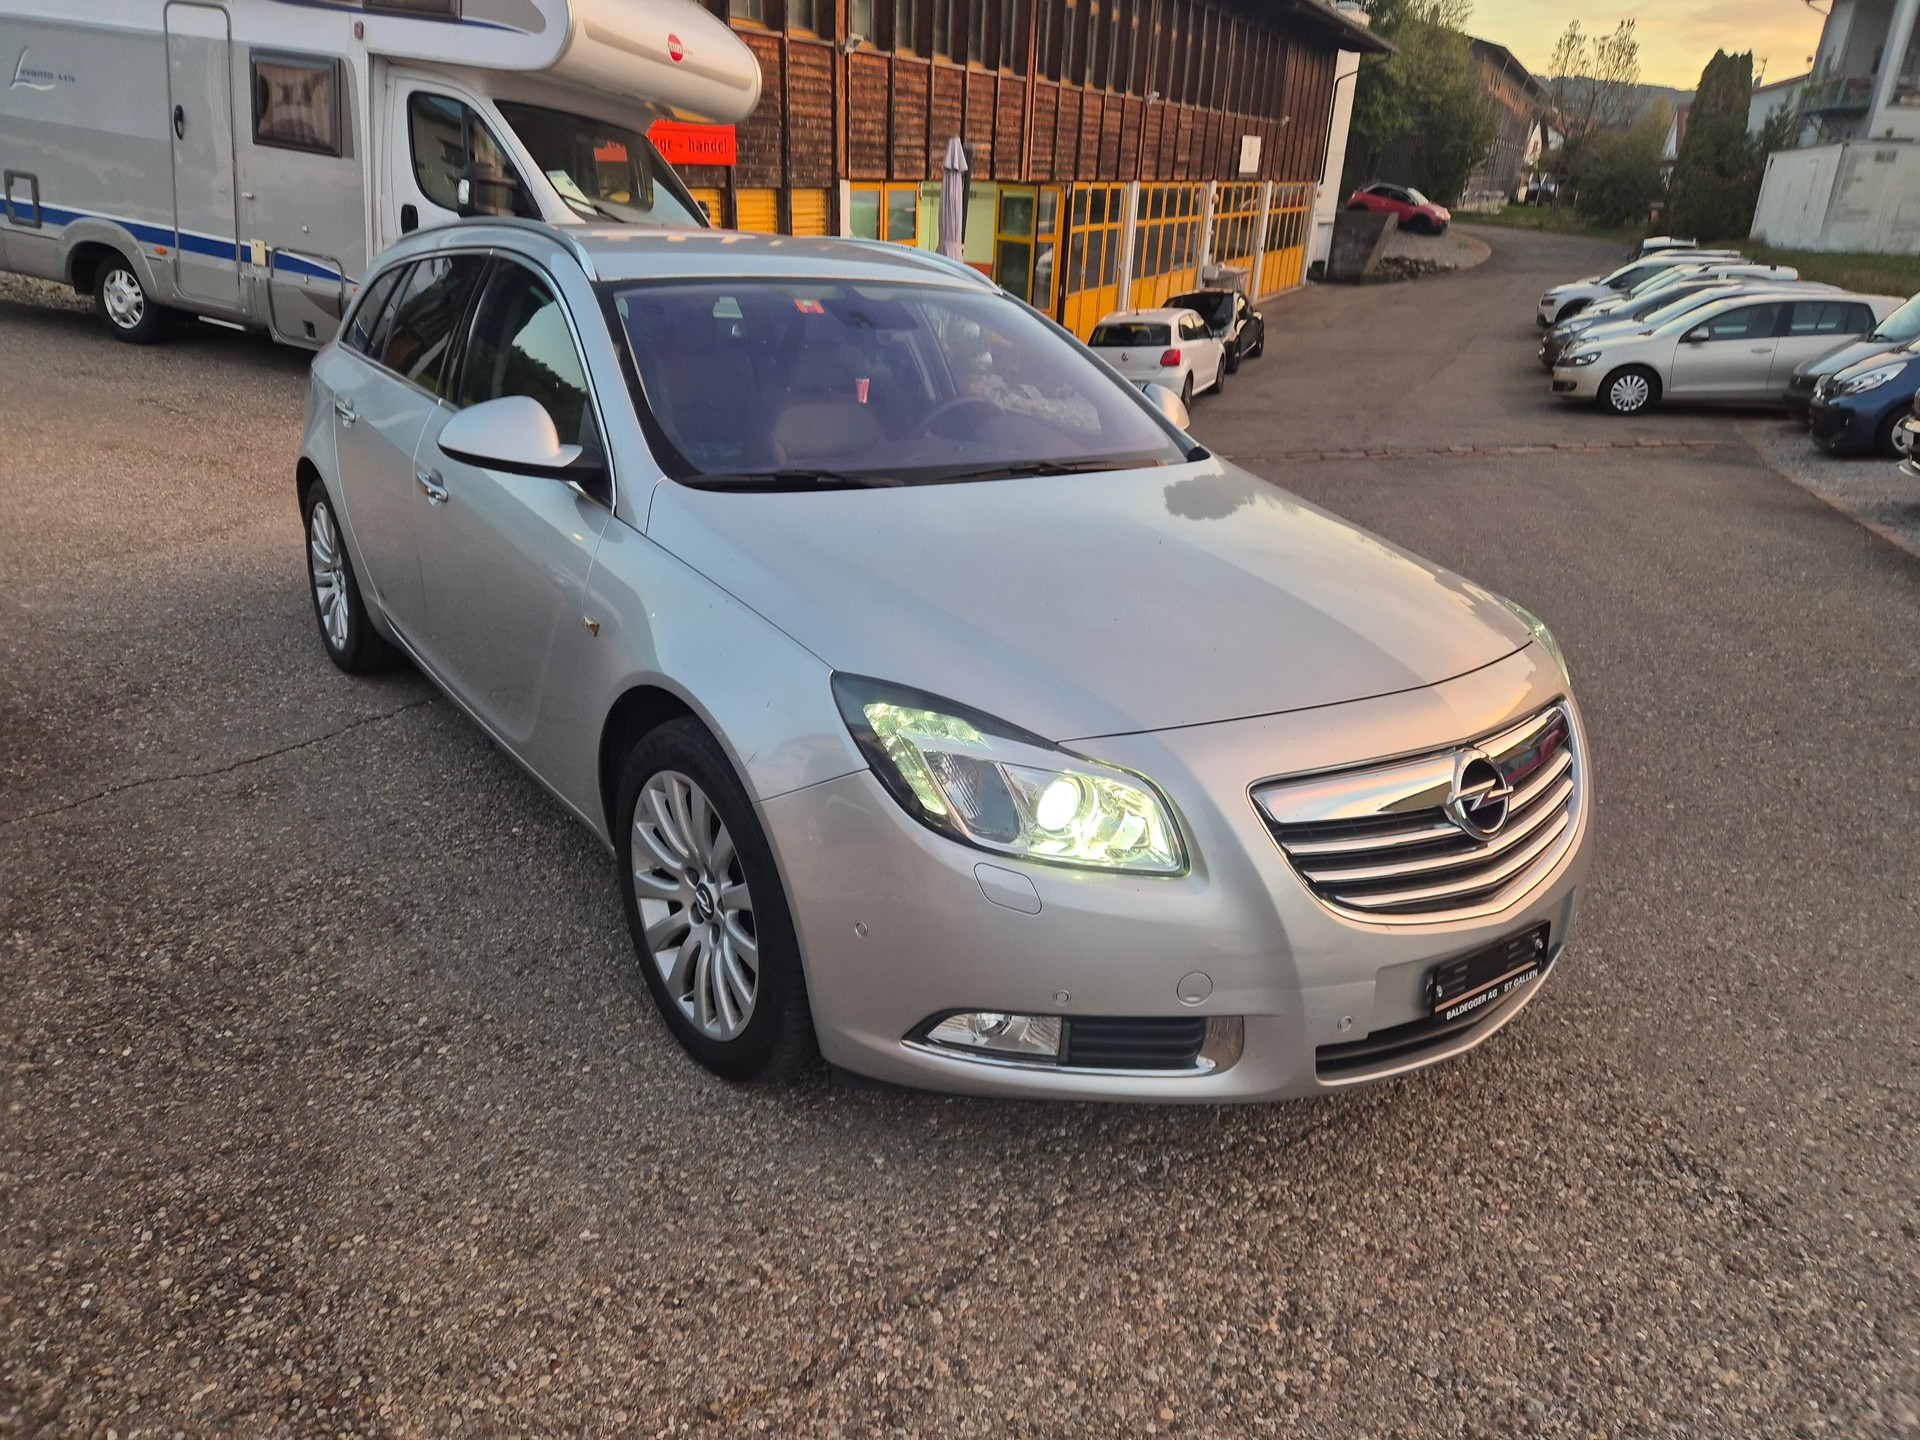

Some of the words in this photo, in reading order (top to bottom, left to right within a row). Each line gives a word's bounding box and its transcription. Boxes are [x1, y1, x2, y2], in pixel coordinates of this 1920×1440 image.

[688, 136, 727, 153] handel
[1446, 994, 1487, 1020] BALDEGGER
[1487, 988, 1498, 1000] AG
[1513, 968, 1538, 987] GALLEN
